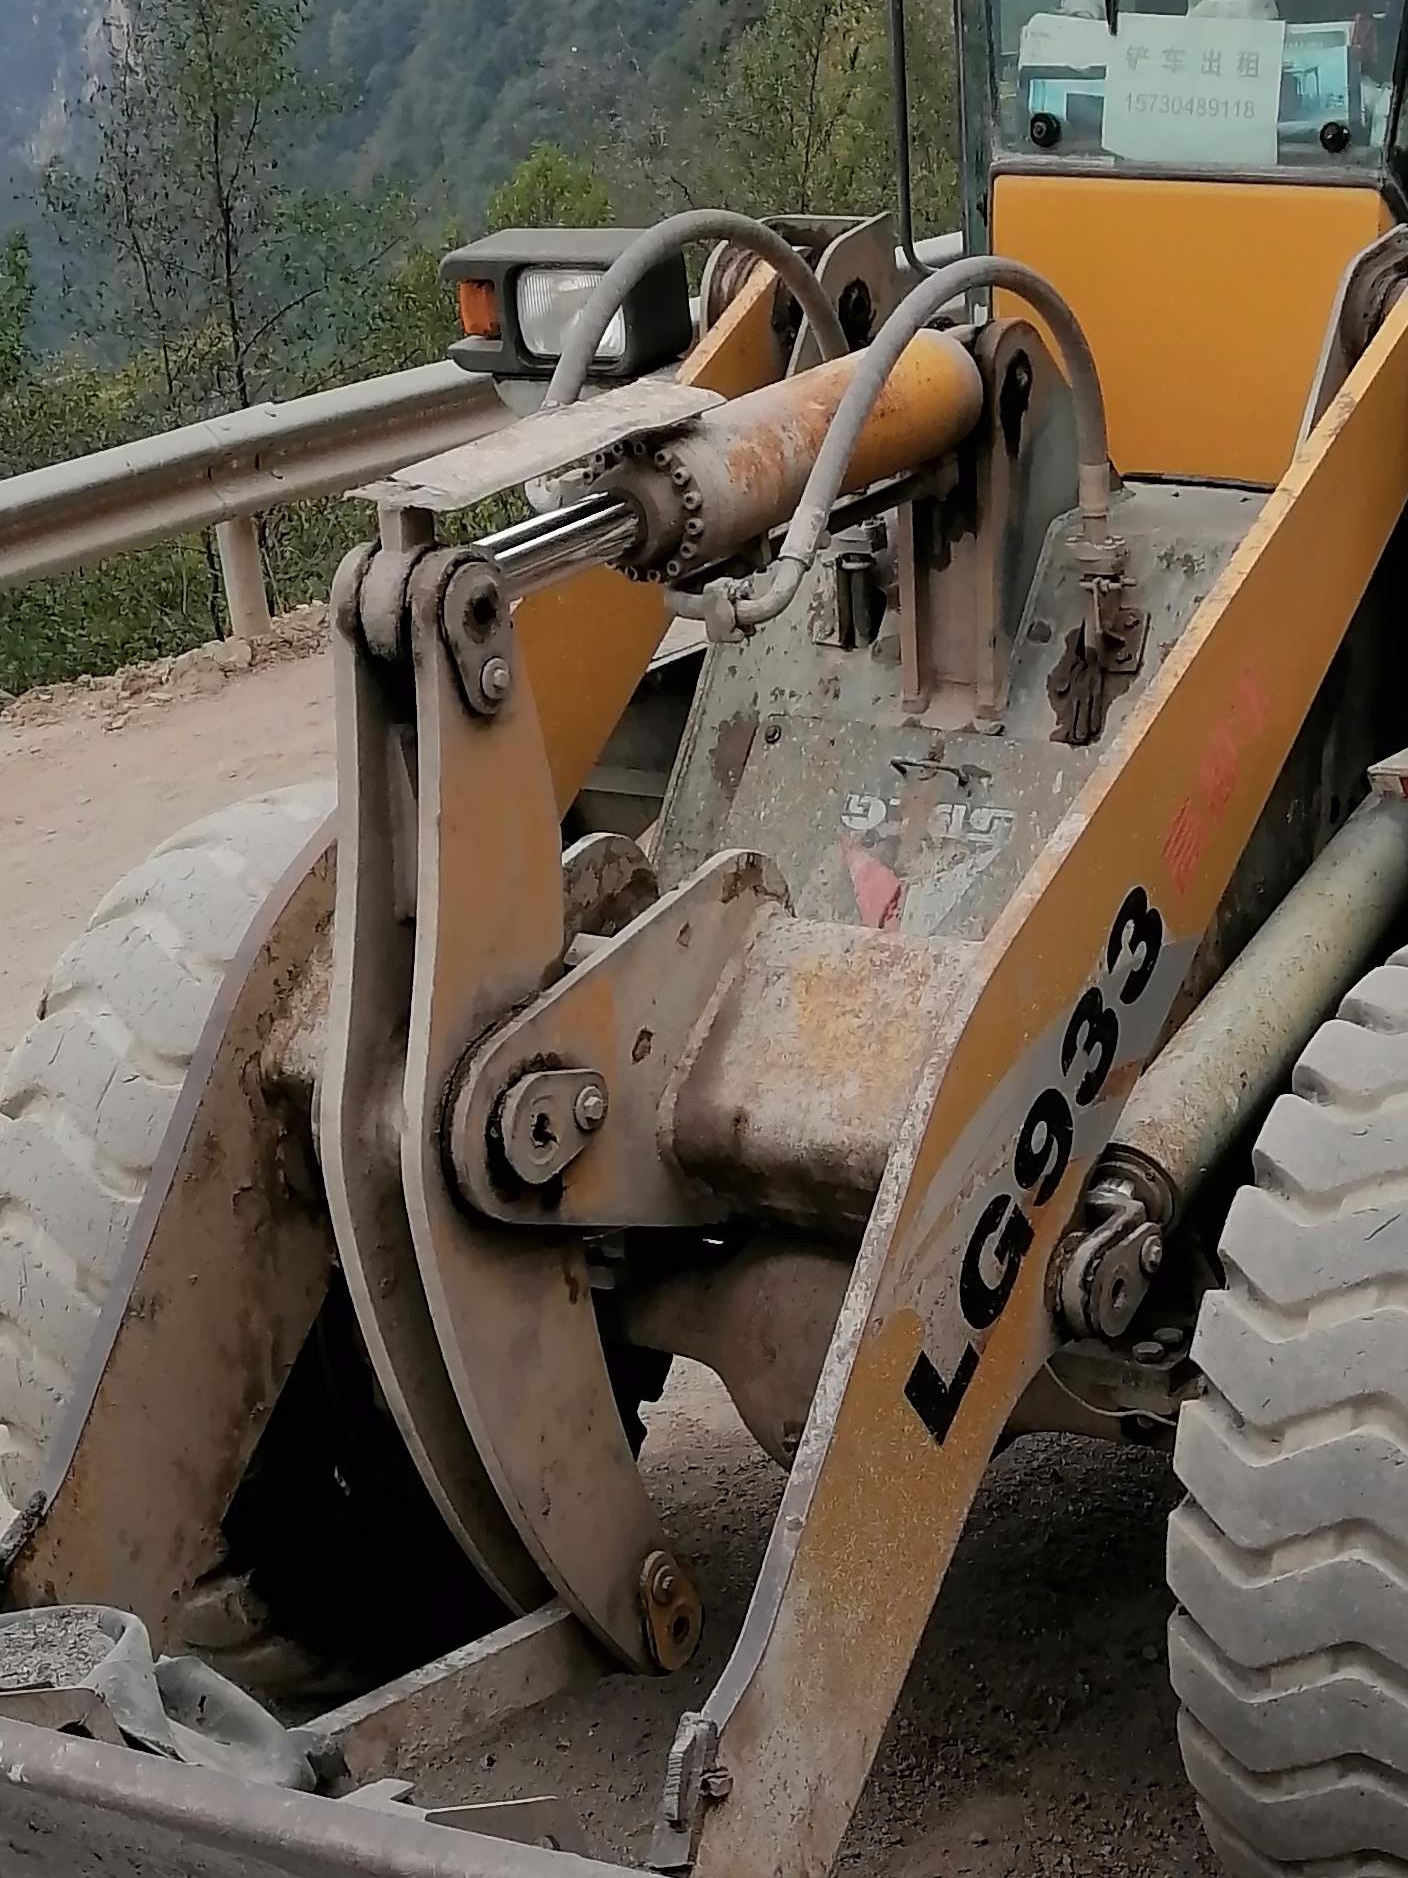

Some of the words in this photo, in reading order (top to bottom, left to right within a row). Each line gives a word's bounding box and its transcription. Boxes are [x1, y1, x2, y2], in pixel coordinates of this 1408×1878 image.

[1125, 44, 1260, 78] 铲车出租
[1125, 92, 1255, 119] 15730489118
[842, 794, 1016, 843] SDG
[904, 885, 1163, 1446] LG933
